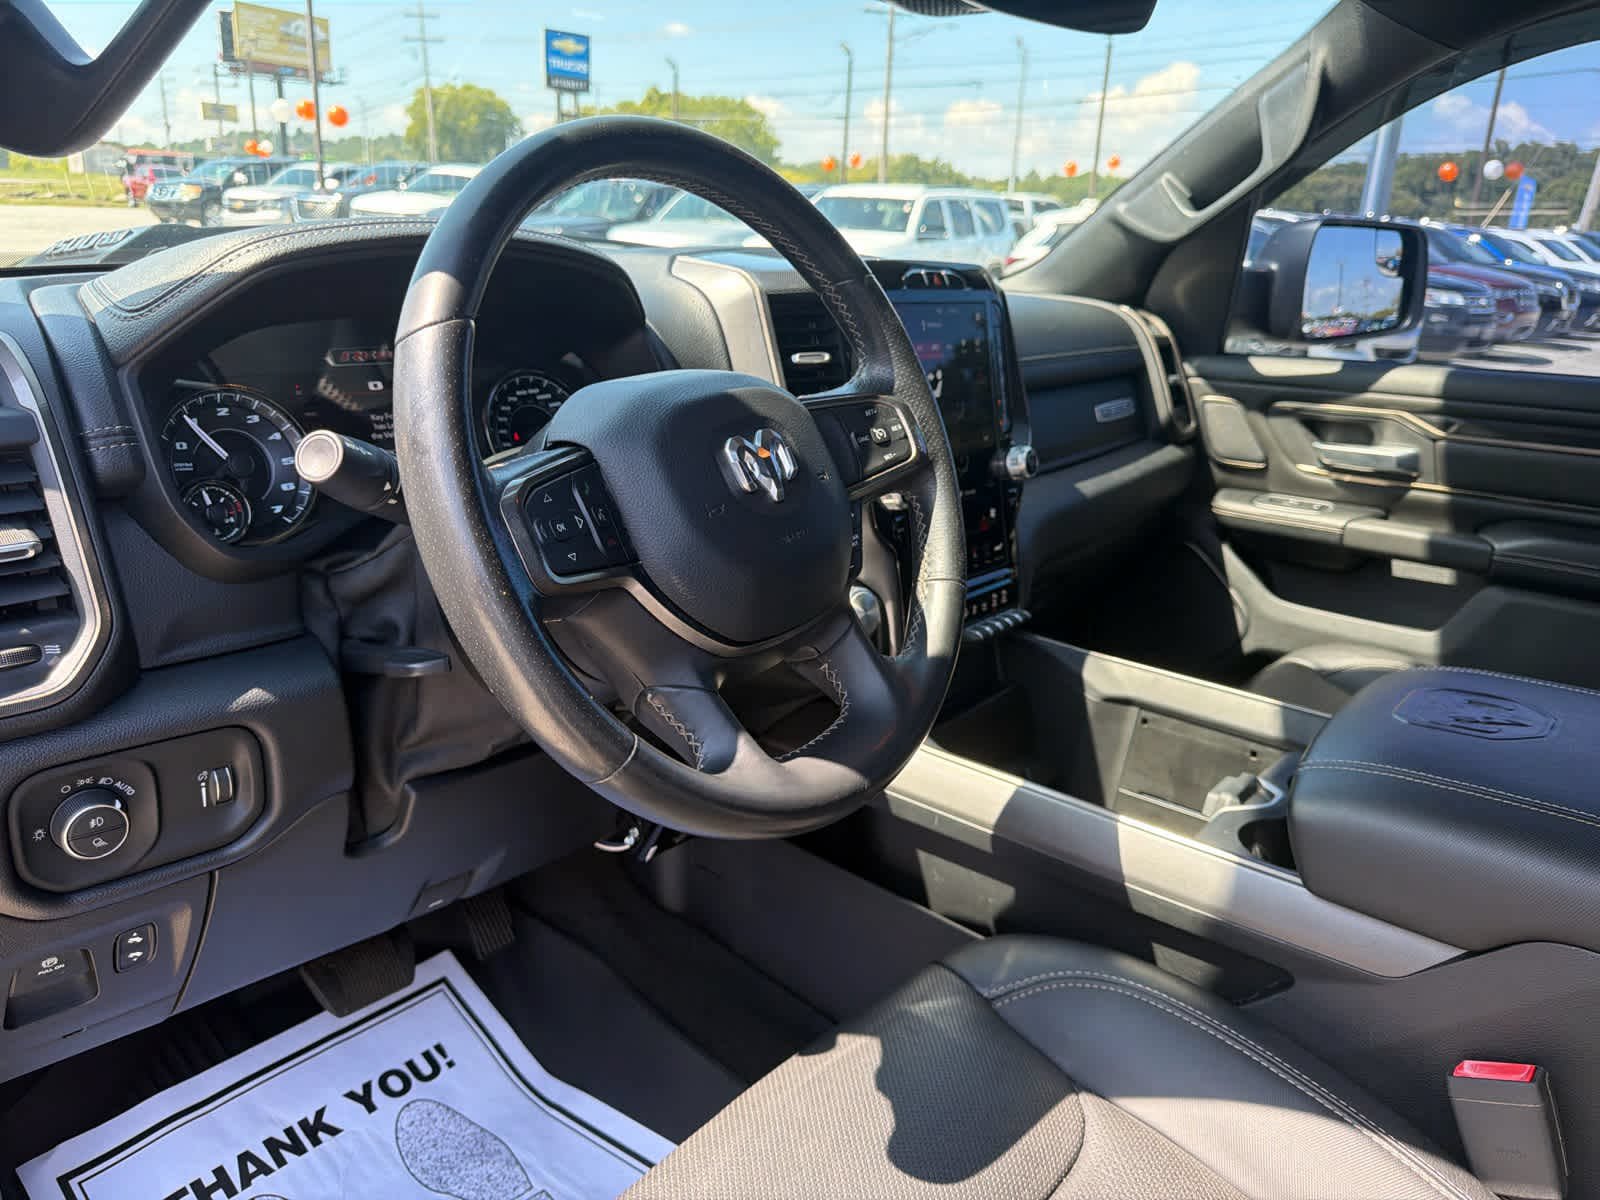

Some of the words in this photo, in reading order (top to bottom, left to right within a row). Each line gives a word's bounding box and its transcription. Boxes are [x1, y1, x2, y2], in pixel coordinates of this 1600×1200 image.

[367, 380, 384, 391] 0
[216, 407, 231, 417] 2
[245, 414, 261, 424] 3
[267, 431, 283, 441] 4
[175, 441, 188, 450] 0
[281, 456, 294, 466] 5
[280, 482, 296, 492] 6
[270, 504, 284, 514] 7
[114, 780, 136, 796] AUTO
[342, 1042, 456, 1115] YOU!
